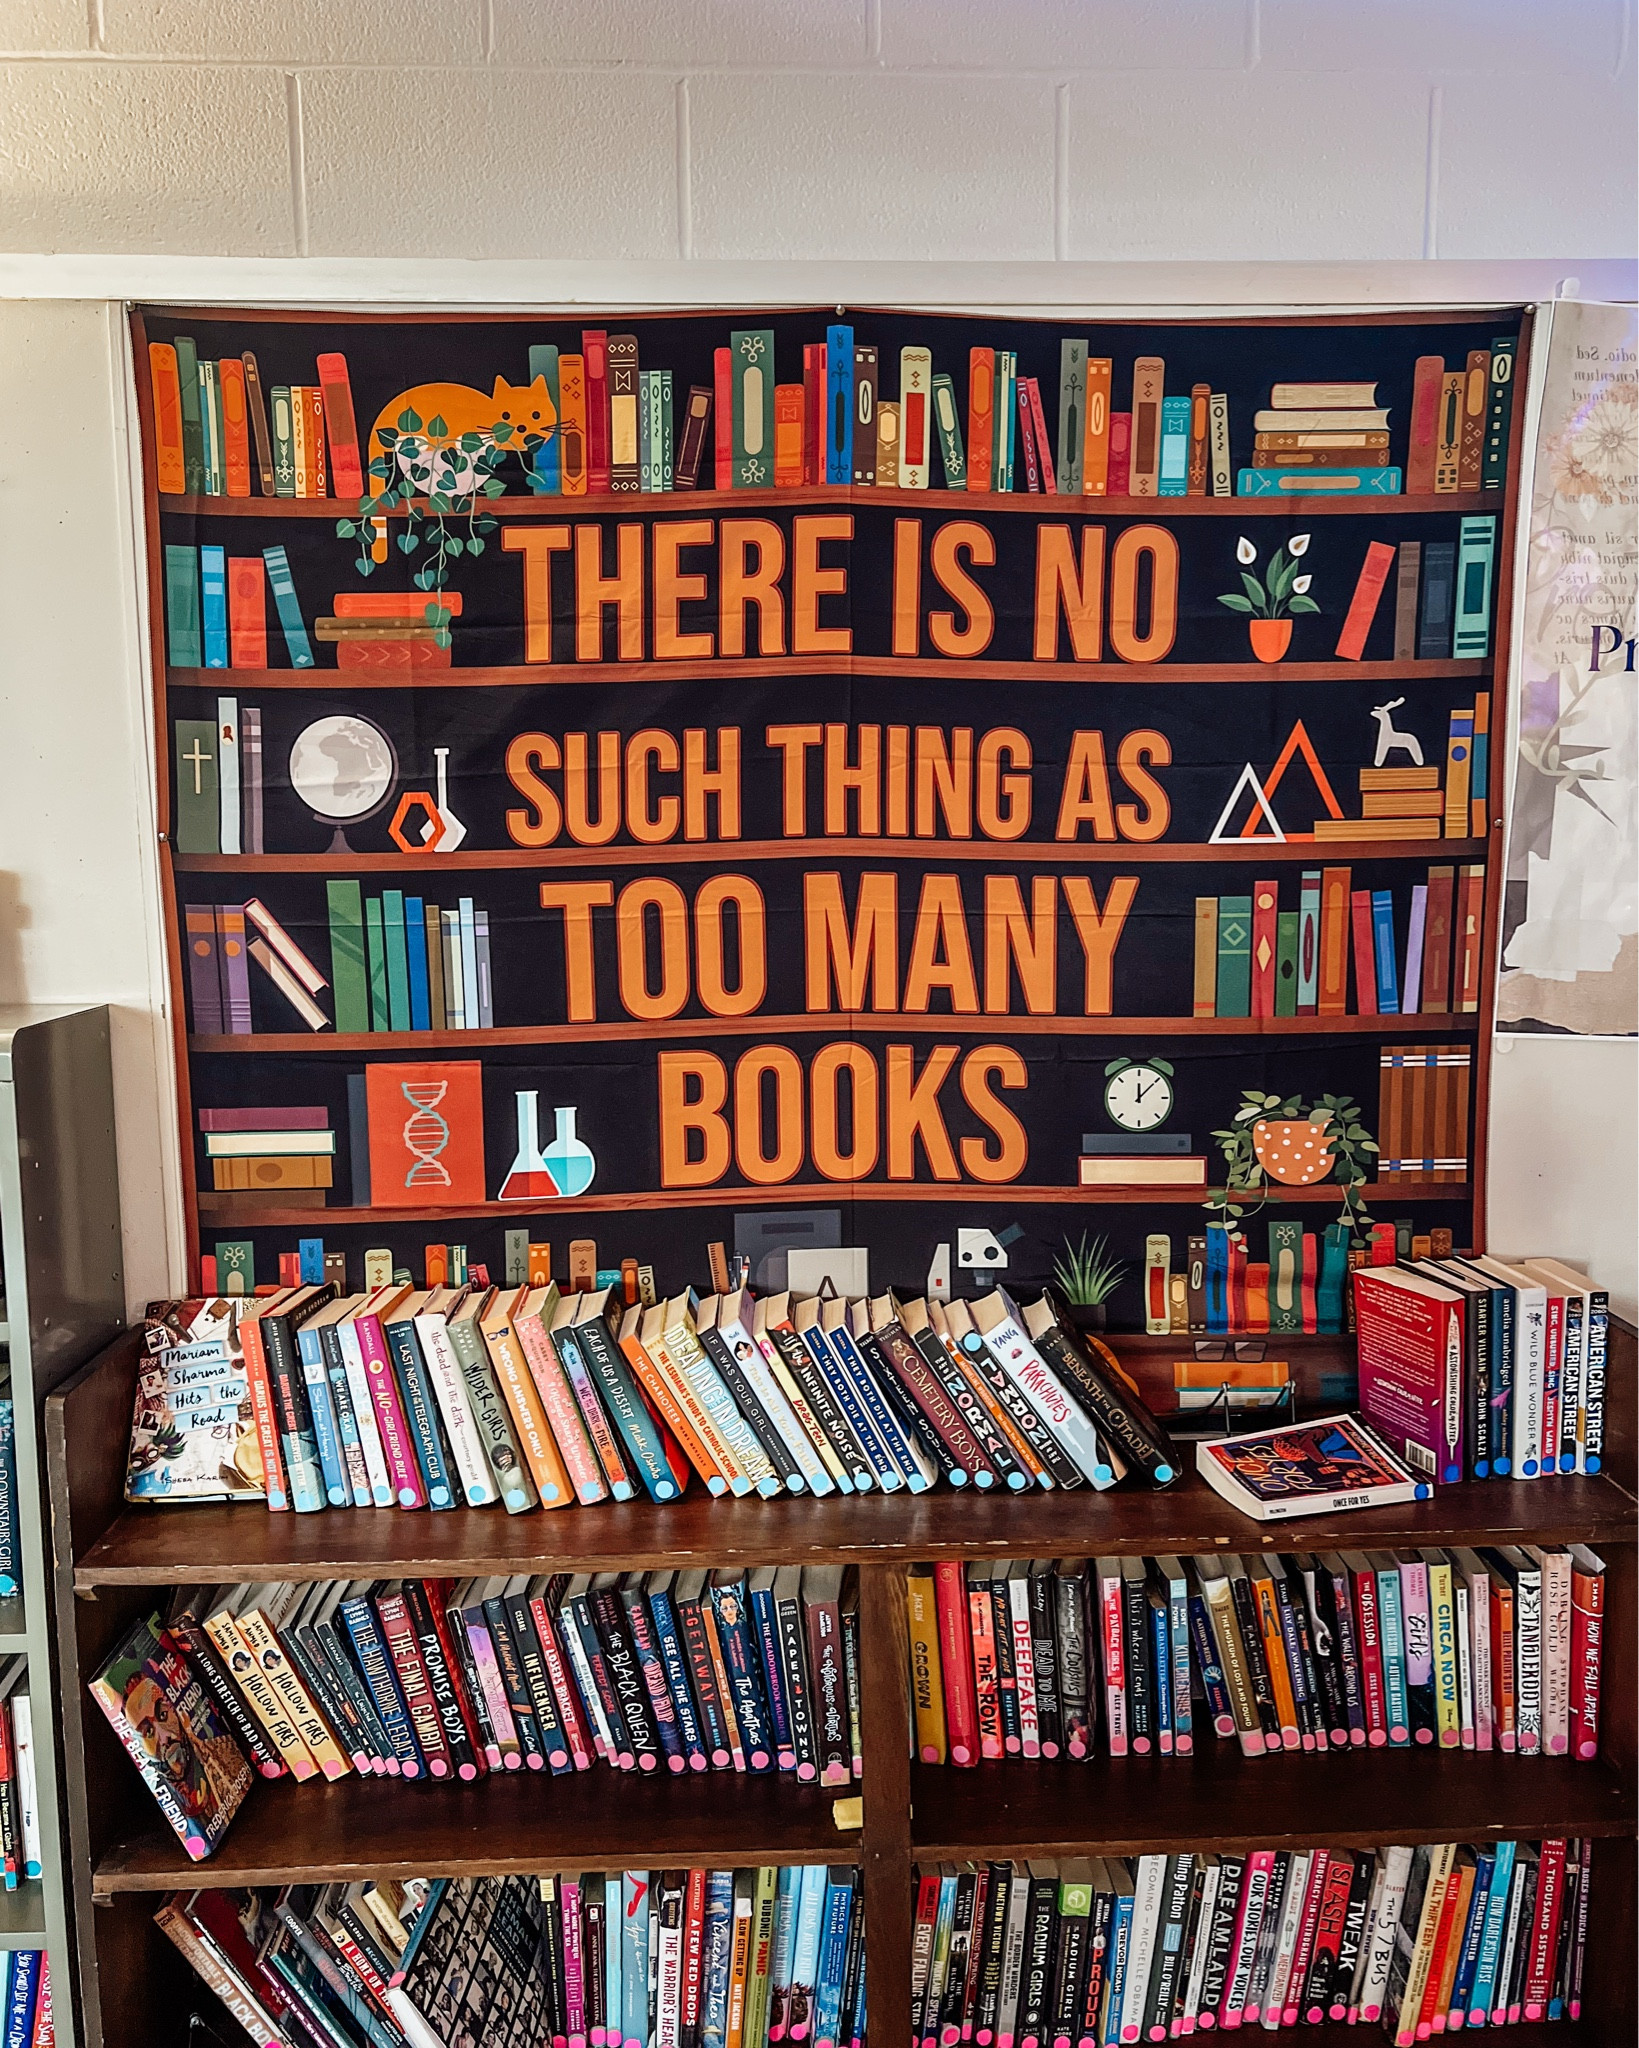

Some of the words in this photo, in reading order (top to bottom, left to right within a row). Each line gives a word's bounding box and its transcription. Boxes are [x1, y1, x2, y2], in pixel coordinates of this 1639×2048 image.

[501, 513, 853, 664] THERE
[892, 518, 997, 658] IS
[1033, 523, 1180, 664] NO
[505, 727, 741, 848] SUCH
[766, 722, 1033, 842] THING
[1055, 729, 1172, 842] AS
[540, 873, 768, 1023] TOO
[803, 872, 1140, 1016] MANY
[657, 1041, 1030, 1189] BOOKS
[1478, 1298, 1488, 1333] STARTER
[166, 1347, 220, 1365] Mariam
[399, 1343, 414, 1366] LAST
[583, 1329, 603, 1352] EACH
[597, 1351, 609, 1364] OF
[1478, 1335, 1487, 1372] VILLAIN
[173, 1367, 227, 1385] Sharma
[601, 1365, 613, 1377] US
[991, 1328, 1019, 1349] YANG
[1017, 1358, 1072, 1423] PARACHUTES
[1500, 1332, 1511, 1386] unabridged
[1529, 1360, 1538, 1388] BLUE
[1564, 1327, 1581, 1393] AMERICAN
[1589, 1325, 1606, 1398] AMERICAN
[176, 1393, 203, 1409] Hits
[220, 1385, 241, 1399] the
[334, 1379, 345, 1393] WE
[405, 1368, 421, 1397] NIGHT
[606, 1379, 618, 1387] A
[634, 1356, 649, 1373] THE
[645, 1375, 680, 1425] CHARIOTEER
[707, 1336, 718, 1345] IF
[719, 1354, 735, 1376] WAS
[733, 1378, 753, 1406] YOUR
[750, 1408, 766, 1432] GIRL
[191, 1408, 225, 1428] Road
[338, 1394, 349, 1409] ARE
[464, 1362, 495, 1409] WILDER
[482, 1408, 506, 1441] GIRLS
[498, 1343, 519, 1382] WRONG
[510, 1384, 535, 1430] ANSWERS
[527, 1433, 544, 1459] ONLY
[611, 1386, 635, 1420] DESERT
[800, 1367, 836, 1419] INFINITE
[828, 1418, 857, 1461] NOISE
[901, 1355, 960, 1430] CEMETERY
[950, 1429, 985, 1472] BOYS
[1478, 1397, 1487, 1421] JOHN
[1528, 1392, 1538, 1439] WONDER
[1563, 1395, 1577, 1441] STREET
[340, 1411, 352, 1433] OKAY
[414, 1402, 436, 1456] TELEGRAPH
[1477, 1423, 1487, 1456] SCALZI
[1586, 1400, 1602, 1454] STREET
[426, 1456, 441, 1479] CLUB
[1333, 1498, 1347, 1508] ONCE
[1348, 1498, 1359, 1506] FOR
[1359, 1496, 1370, 1504] YES
[1108, 1598, 1116, 1611] THE
[1591, 1582, 1599, 1608] ZHAO
[656, 1600, 668, 1626] FRICK
[1109, 1613, 1121, 1648] PAYBACK
[1341, 1621, 1349, 1637] THE
[1437, 1604, 1453, 1656] CIRCA
[352, 1623, 377, 1649] THE
[389, 1629, 416, 1658] THE
[608, 1632, 623, 1649] THE
[663, 1635, 677, 1657] SEE
[1342, 1637, 1354, 1664] WALLS
[1586, 1621, 1600, 1645] HOW
[514, 1610, 527, 1633] CESARE
[523, 1652, 557, 1731] INFLUENCER
[668, 1660, 681, 1680] ALL
[977, 1654, 991, 1683] THE
[1034, 1639, 1054, 1675] DEAD
[1110, 1650, 1120, 1672] GIRLS
[1175, 1644, 1189, 1666] KILL
[1521, 1614, 1540, 1711] TANGLEROOT
[1585, 1648, 1599, 1664] WE
[362, 1648, 402, 1716] HAWTHORNE
[397, 1660, 428, 1701] FINAL
[606, 1650, 640, 1700] BLACK
[786, 1623, 800, 1683] PAPER
[794, 1699, 809, 1759] TOWNS
[1014, 1620, 1037, 1731] DEEPFAKE
[1037, 1677, 1052, 1693] TO
[1175, 1666, 1191, 1718] CREATURES
[1345, 1665, 1357, 1695] AROUND
[1440, 1660, 1455, 1702] NOW
[1583, 1665, 1599, 1693] FALL
[674, 1683, 689, 1704] THE
[1038, 1694, 1058, 1713] ME
[1347, 1697, 1359, 1707] US
[411, 1704, 444, 1752] GAMBIT
[624, 1703, 657, 1750] QUEEN
[679, 1707, 697, 1742] STARS
[979, 1693, 998, 1736] ROW
[1583, 1695, 1598, 1733] APART
[385, 1716, 417, 1762] LEGACY
[1547, 1857, 1557, 1865] A
[1144, 1855, 1160, 1912] BECOMING
[1319, 1866, 1351, 1935] SLASH
[1432, 1879, 1444, 1898] ALL
[1542, 1869, 1556, 1930] THOUSAND
[284, 1915, 304, 1937] COOPER
[738, 1918, 747, 1937] SLOW
[759, 1899, 772, 1939] BUBONIC
[1204, 1864, 1242, 2007] DREAMLAND
[1338, 1901, 1367, 1972] TWEAK
[1422, 1898, 1441, 1947] THIRTEEN
[736, 1939, 746, 1966] GETTING
[1032, 1914, 1050, 1966] RADIUM
[1067, 1933, 1080, 1979] RADIUM
[1136, 1928, 1149, 1979] MICHELLE
[1535, 1933, 1548, 1976] SISTERS
[345, 1946, 353, 1954] A
[350, 1952, 371, 1977] HOME
[368, 1975, 380, 1989] ON
[735, 1967, 743, 1977] UP
[756, 1941, 768, 1976] PANIC
[733, 1983, 742, 1999] NATE
[1028, 1969, 1043, 2007] GIRLS
[1063, 1985, 1075, 2019] GIRLS
[1085, 1948, 1104, 2028] PROUD
[1130, 1985, 1142, 2023] OBAMA
[731, 2000, 742, 2031] JACKSON
[36, 2024, 54, 2045] SUN
